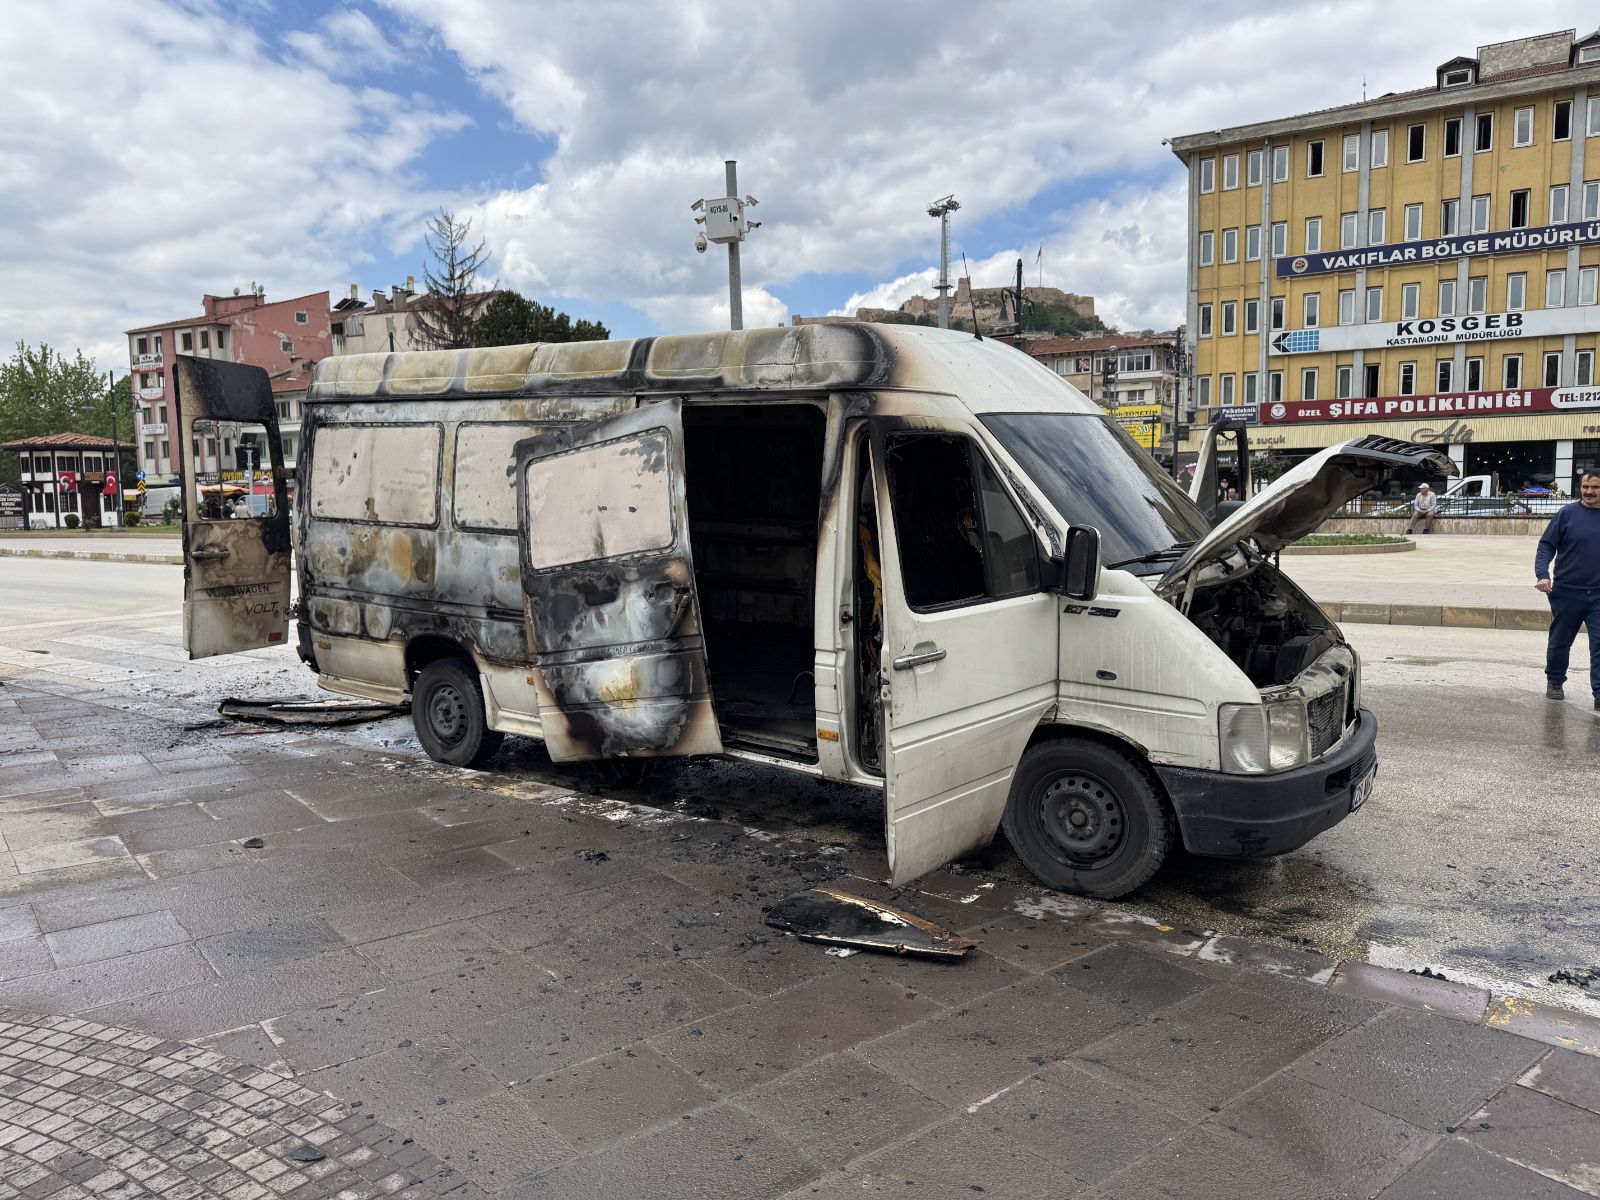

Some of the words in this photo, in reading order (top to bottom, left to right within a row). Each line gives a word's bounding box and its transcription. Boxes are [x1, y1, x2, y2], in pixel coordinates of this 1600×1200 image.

[1322, 248, 1417, 270] VAKIFLAR
[1421, 240, 1489, 259] BÖLGE
[1494, 223, 1600, 251] MÜDÜRLÜ
[1396, 312, 1524, 337] KOSGEB
[1455, 327, 1522, 341] MÜDÜRLÜĞÜ
[1297, 408, 1322, 417] ÖZEL
[1329, 400, 1379, 418] ŞİFA
[1384, 391, 1532, 414] POLİKLİNİĞİ
